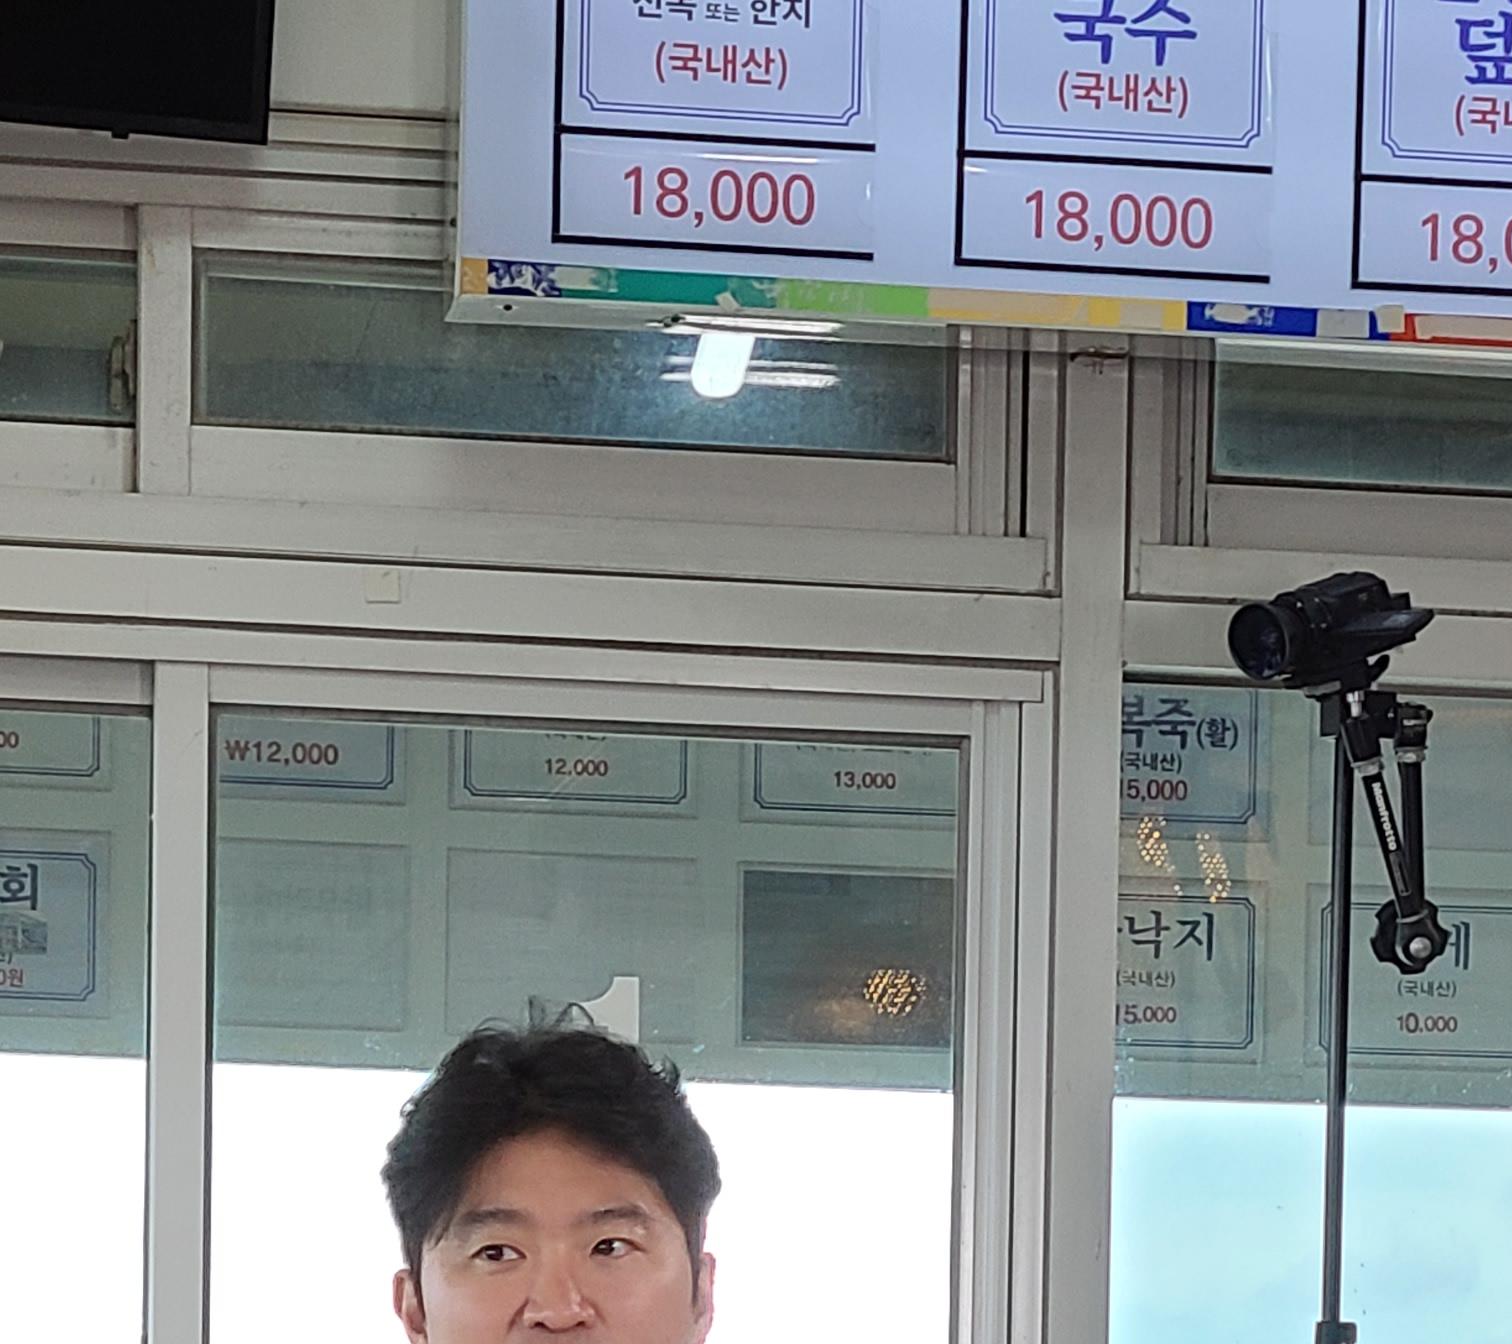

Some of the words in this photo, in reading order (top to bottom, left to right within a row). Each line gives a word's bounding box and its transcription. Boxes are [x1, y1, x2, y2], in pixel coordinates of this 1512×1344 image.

[1053, 0, 1198, 66] 국수
[656, 40, 788, 91] (국내산)
[1058, 70, 1189, 119] (국내산)
[624, 165, 815, 228] 18,000
[1025, 189, 1213, 251] 18,000
[1371, 782, 1398, 851] Manfrotto
[1117, 910, 1215, 961] 낙지
[1397, 980, 1457, 998] (국내산)
